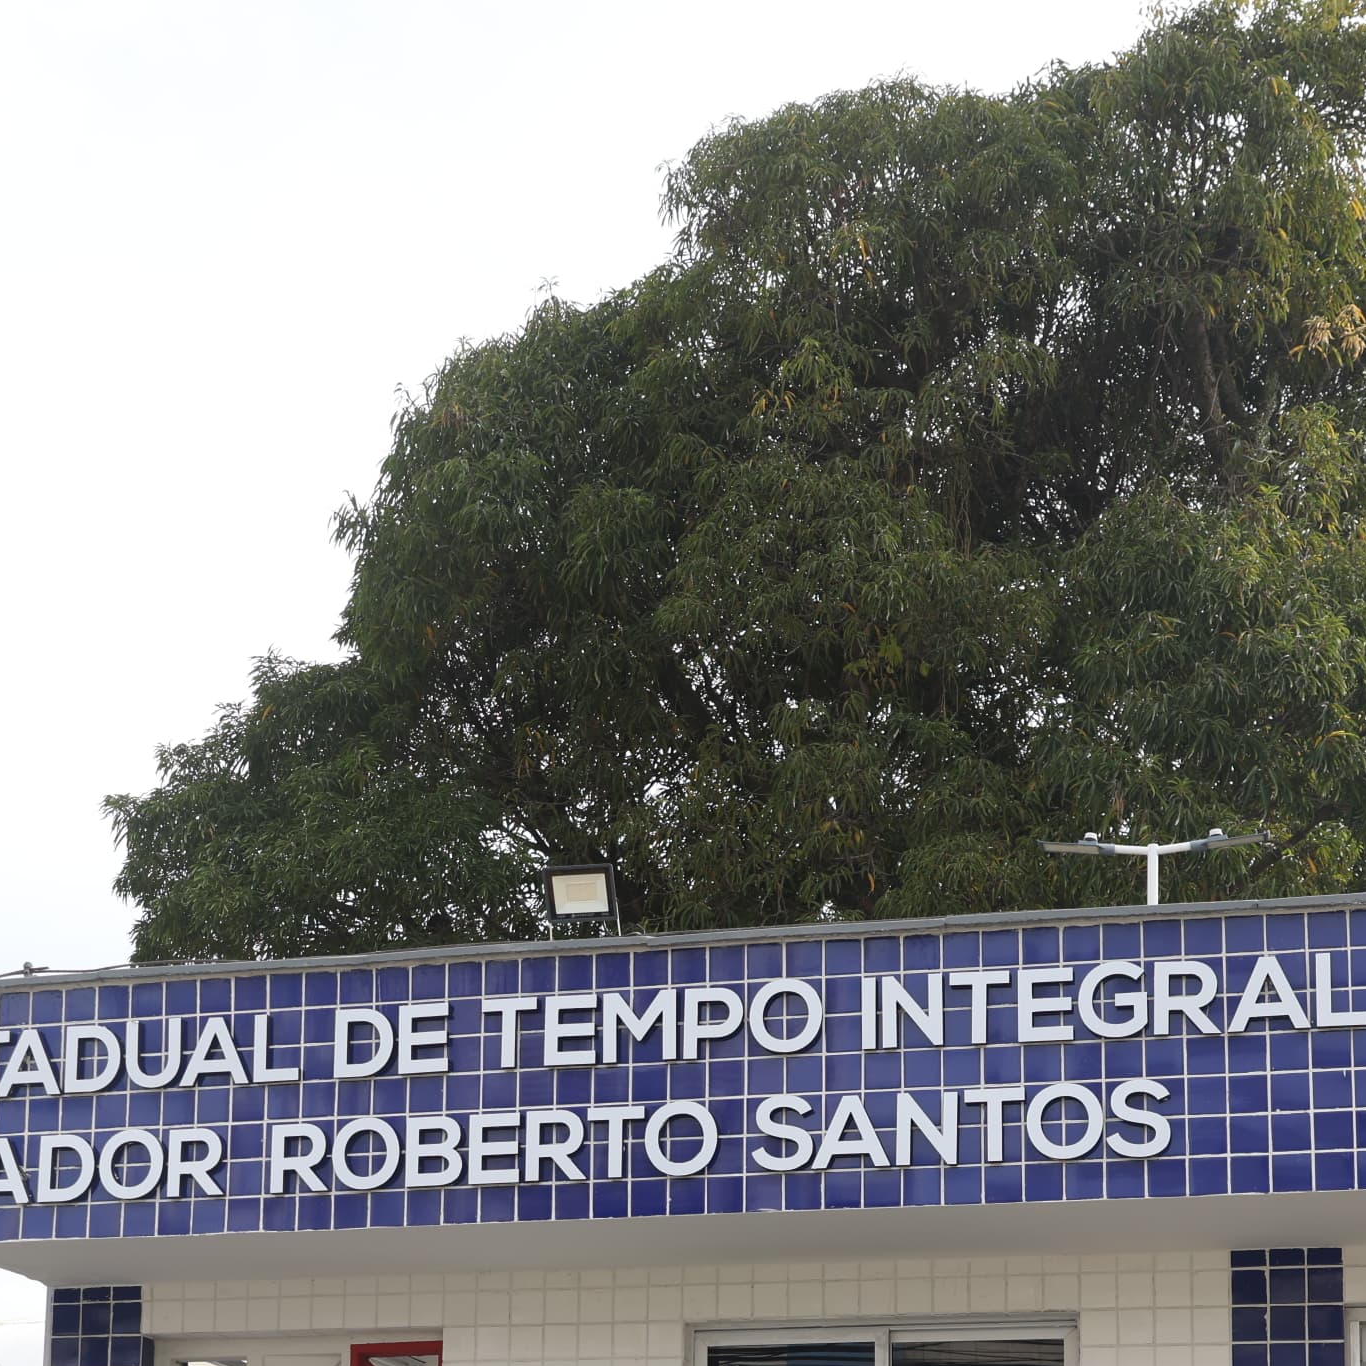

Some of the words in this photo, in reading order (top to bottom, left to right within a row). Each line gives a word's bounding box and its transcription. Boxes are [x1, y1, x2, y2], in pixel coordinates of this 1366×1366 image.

[333, 1002, 451, 1080] DE
[481, 977, 825, 1070] TEMPO
[270, 1100, 720, 1196] ROBERTO
[752, 1078, 1173, 1173] SANTOS
